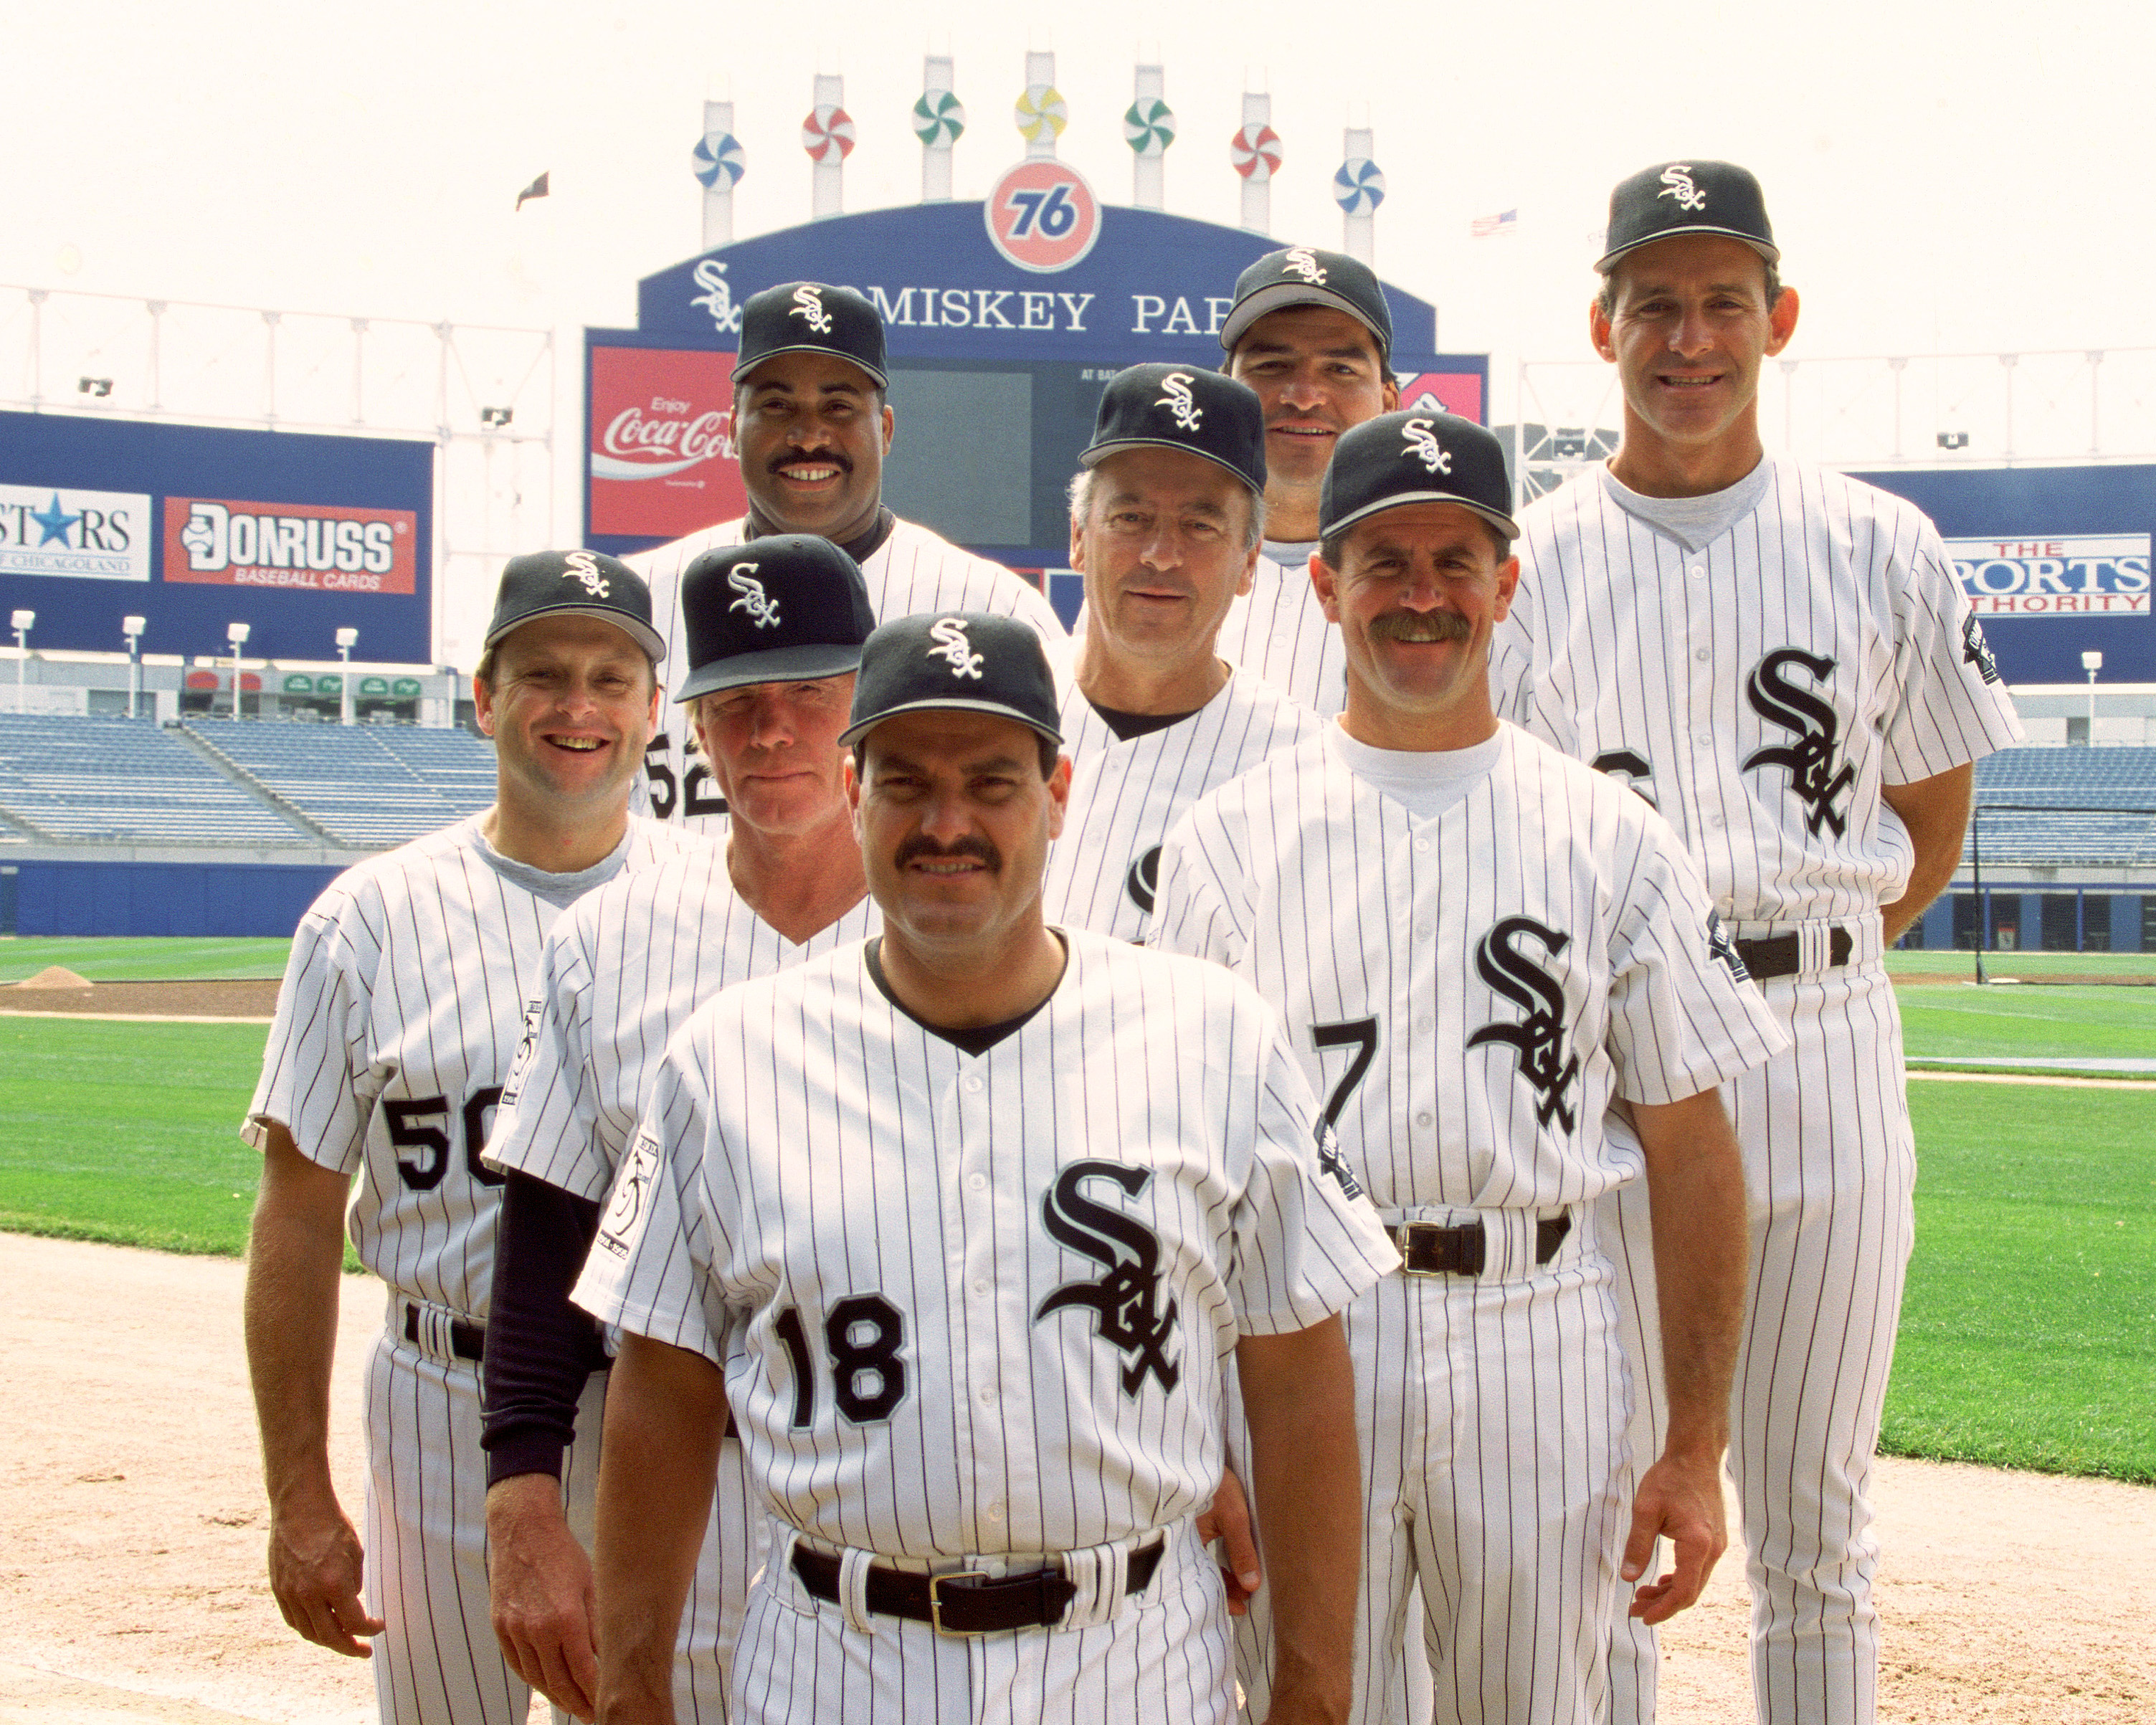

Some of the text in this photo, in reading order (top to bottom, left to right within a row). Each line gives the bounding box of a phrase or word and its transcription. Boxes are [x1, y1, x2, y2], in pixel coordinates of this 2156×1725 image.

[1007, 184, 1077, 239] 76
[867, 285, 1235, 335] MISKEY PA
[1081, 369, 1093, 381] AT
[650, 396, 691, 414] Enjoy
[604, 407, 740, 460] Coca-Co
[11, 555, 130, 573] CHICAGOLAND
[1993, 543, 2064, 557] THE
[234, 569, 381, 591] BASEBALL CARDS
[1952, 556, 2150, 594] PORTS
[1969, 594, 2145, 612] THORITY
[1308, 1013, 1379, 1128] 7
[773, 1291, 909, 1432] 18
